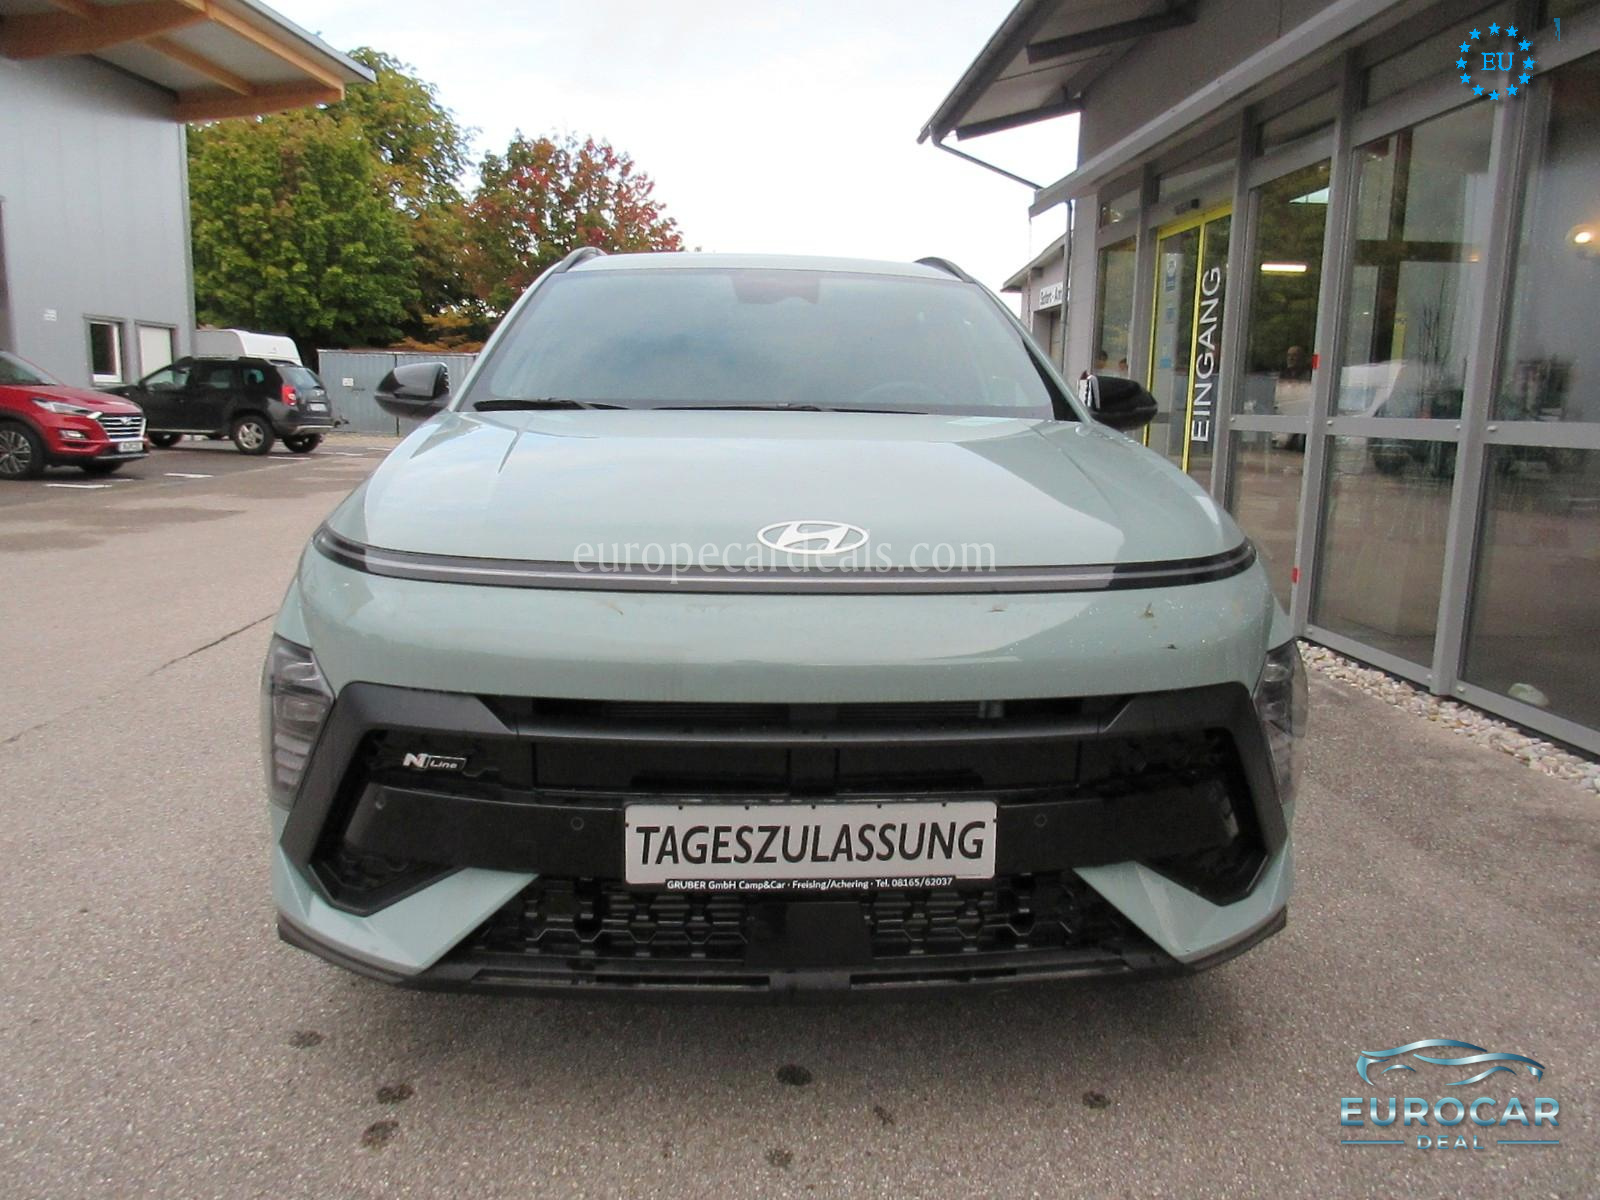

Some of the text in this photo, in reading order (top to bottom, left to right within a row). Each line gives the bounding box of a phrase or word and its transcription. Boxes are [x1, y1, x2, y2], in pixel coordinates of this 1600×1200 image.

[1191, 267, 1220, 442] EINGANG
[430, 760, 458, 769] Line
[635, 821, 986, 865] TAGESZULASSUNG
[667, 880, 706, 890] GRUBER
[708, 880, 737, 890] GmbH
[739, 880, 786, 892] Camp&Car
[875, 879, 890, 888] Tel.
[891, 877, 953, 888] 08165/62037
